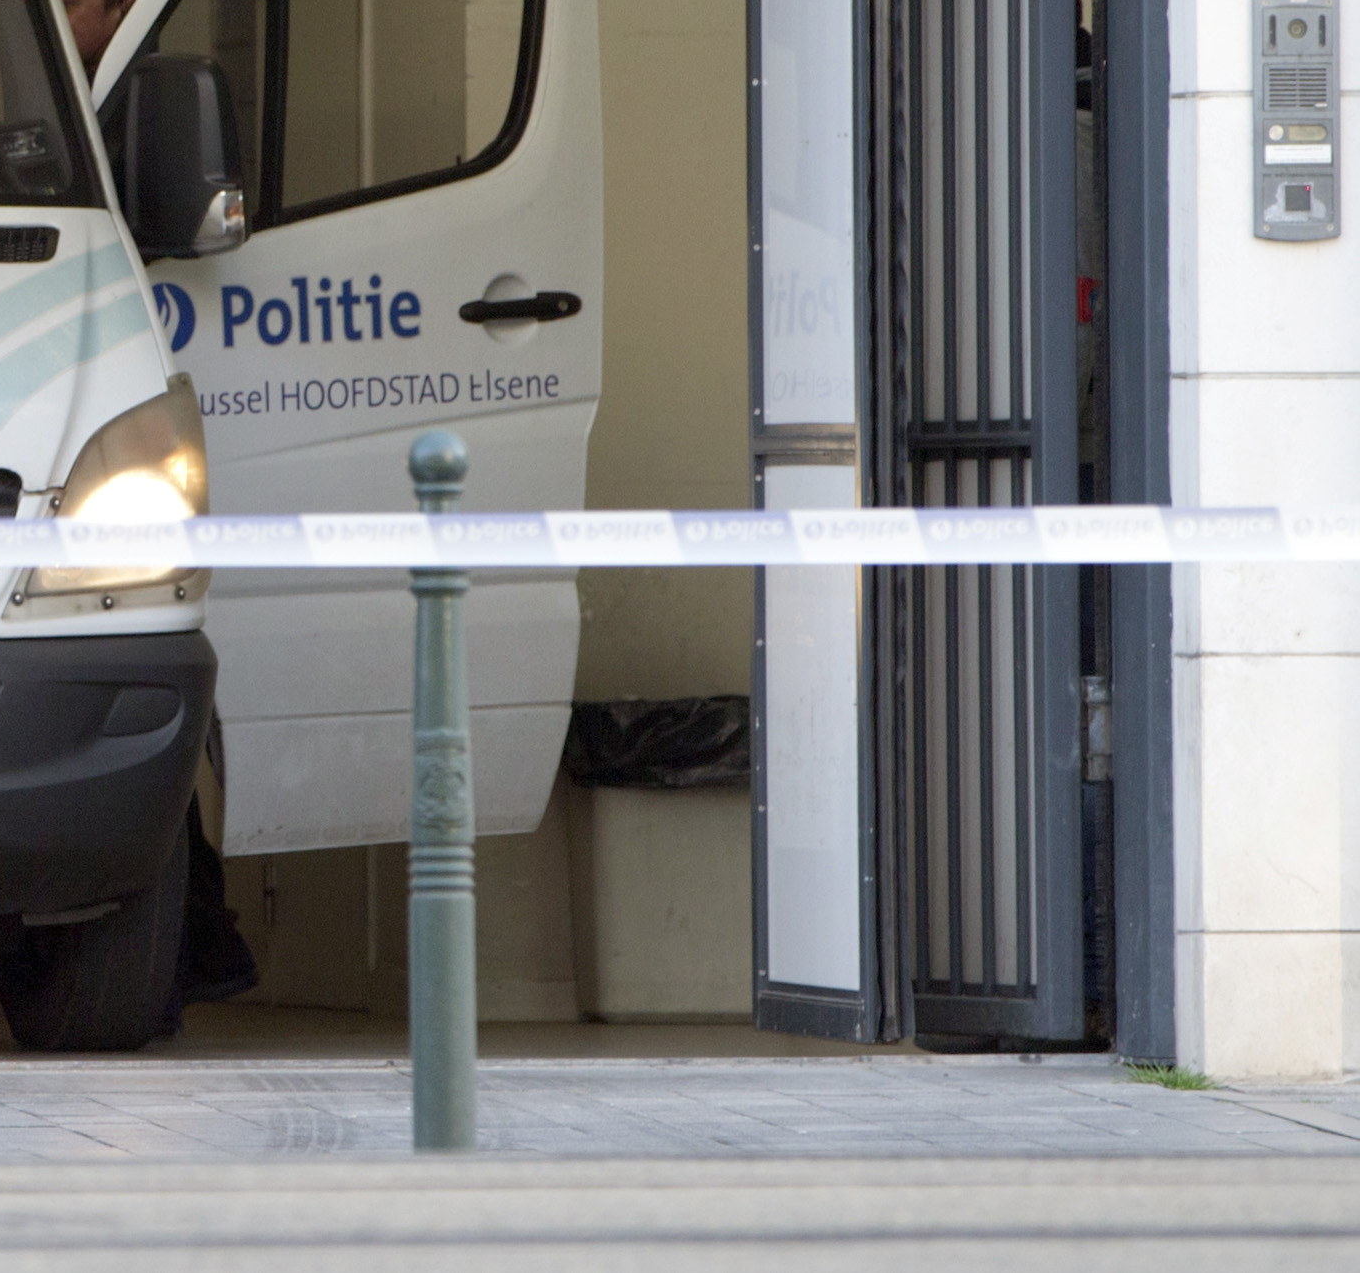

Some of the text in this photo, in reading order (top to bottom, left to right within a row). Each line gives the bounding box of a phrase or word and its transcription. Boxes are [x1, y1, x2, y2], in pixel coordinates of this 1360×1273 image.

[221, 274, 421, 348] Politie
[280, 372, 460, 412] HOOFDSTAD
[469, 369, 559, 402] Elsene
